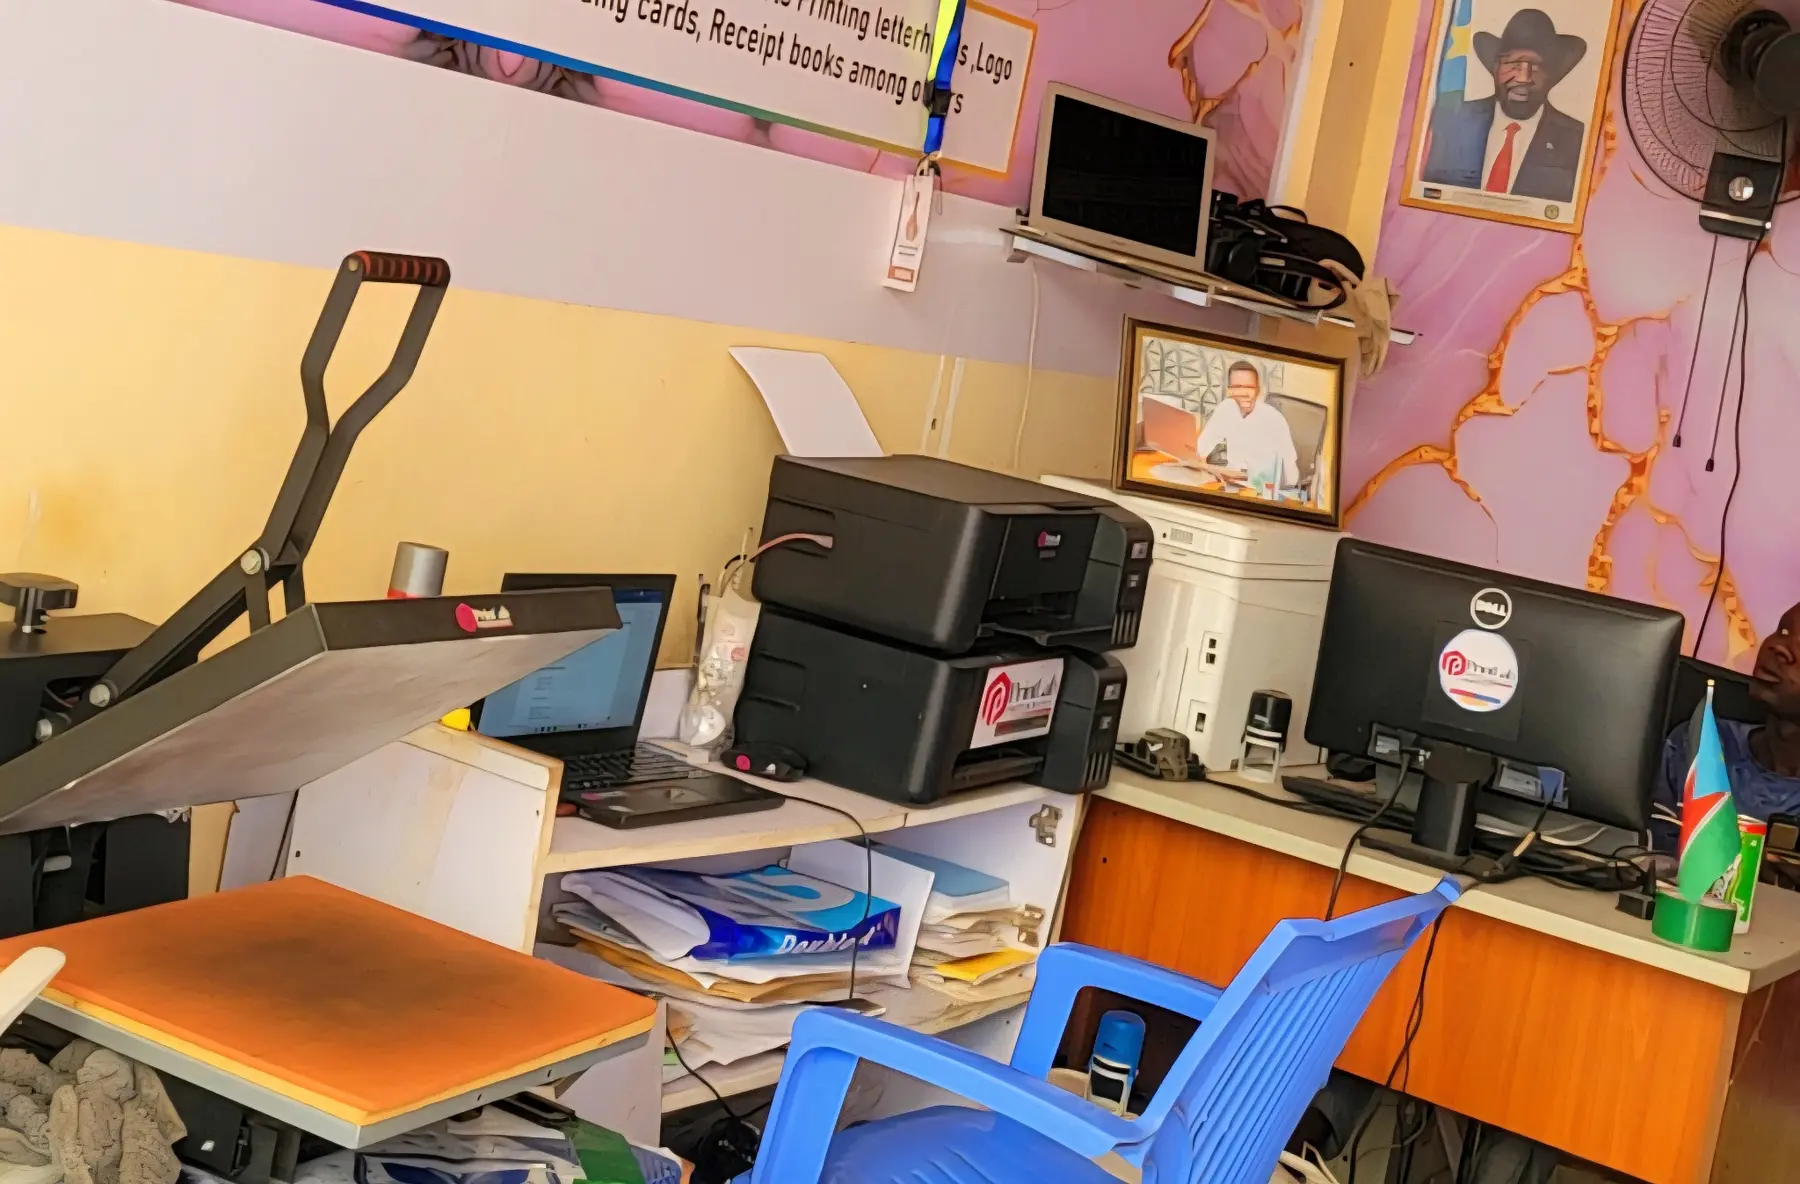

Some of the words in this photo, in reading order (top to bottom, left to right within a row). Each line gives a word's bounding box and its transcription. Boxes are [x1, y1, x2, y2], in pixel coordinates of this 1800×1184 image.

[638, 0, 700, 43] cards,
[709, 8, 785, 66] Receipt
[789, 33, 845, 78] books
[848, 60, 908, 105] among
[875, 7, 968, 66] letterhs
